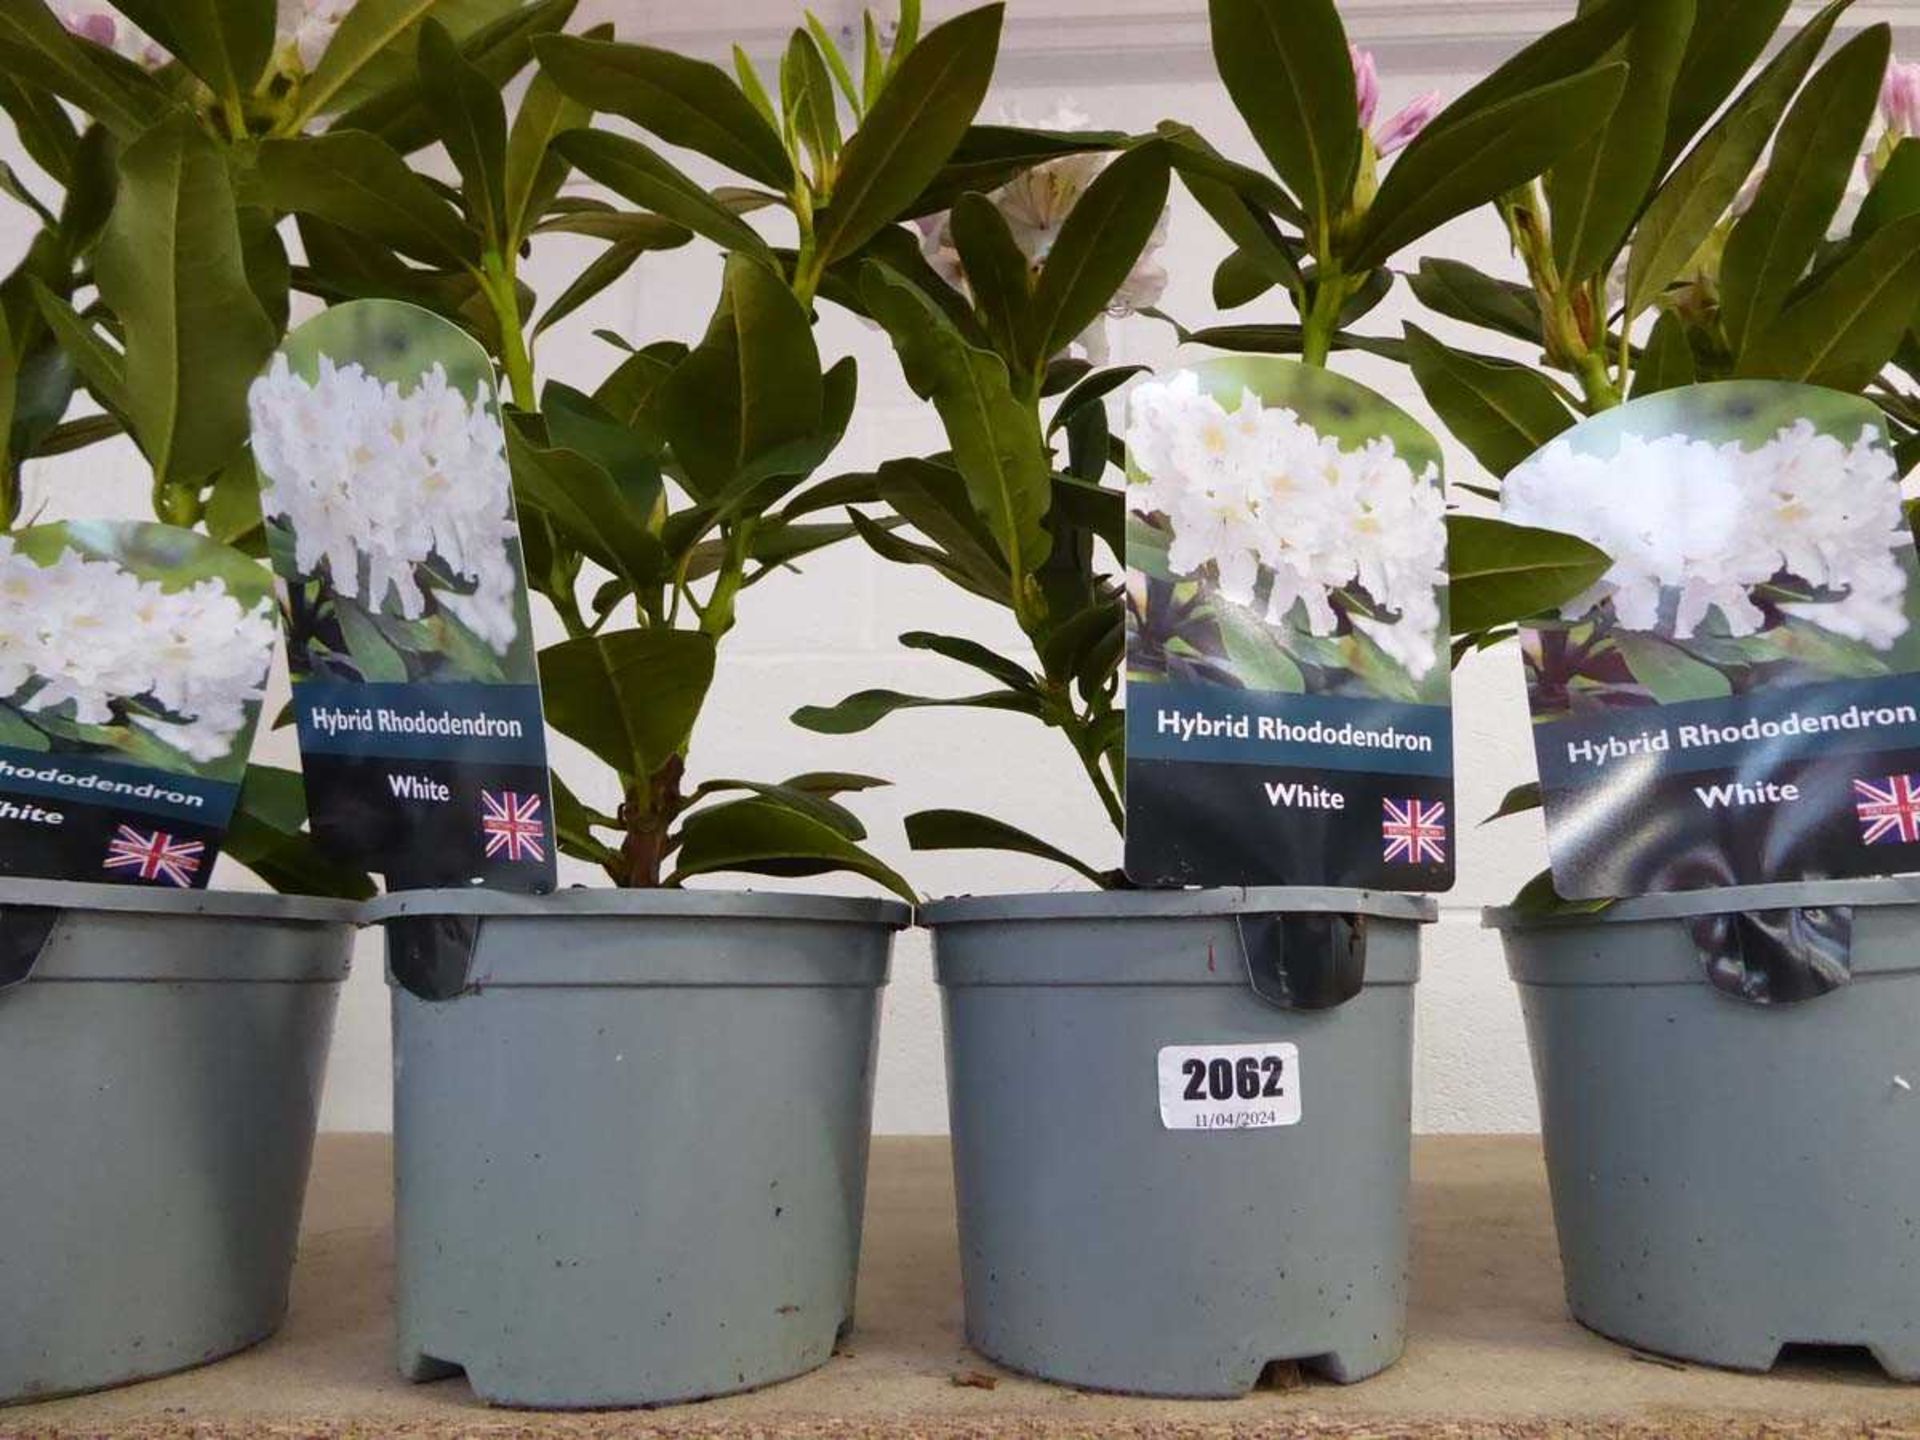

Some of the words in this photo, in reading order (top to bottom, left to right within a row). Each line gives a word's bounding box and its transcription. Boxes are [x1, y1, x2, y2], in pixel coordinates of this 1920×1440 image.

[311, 707, 373, 737] Hybrid
[376, 708, 523, 738] Rhododendron
[1157, 709, 1249, 742] Hybrid
[1257, 716, 1432, 751] Rhododendron
[1567, 729, 1670, 765] Hybrid
[1679, 704, 1917, 749] Rhododendron
[0, 760, 204, 807] hododendron
[388, 774, 450, 802] White
[1264, 782, 1345, 810] White
[1695, 780, 1801, 809] White
[0, 801, 64, 824] hite
[1182, 1055, 1284, 1101] 2062
[1195, 1110, 1276, 1127] 11/04/2024
